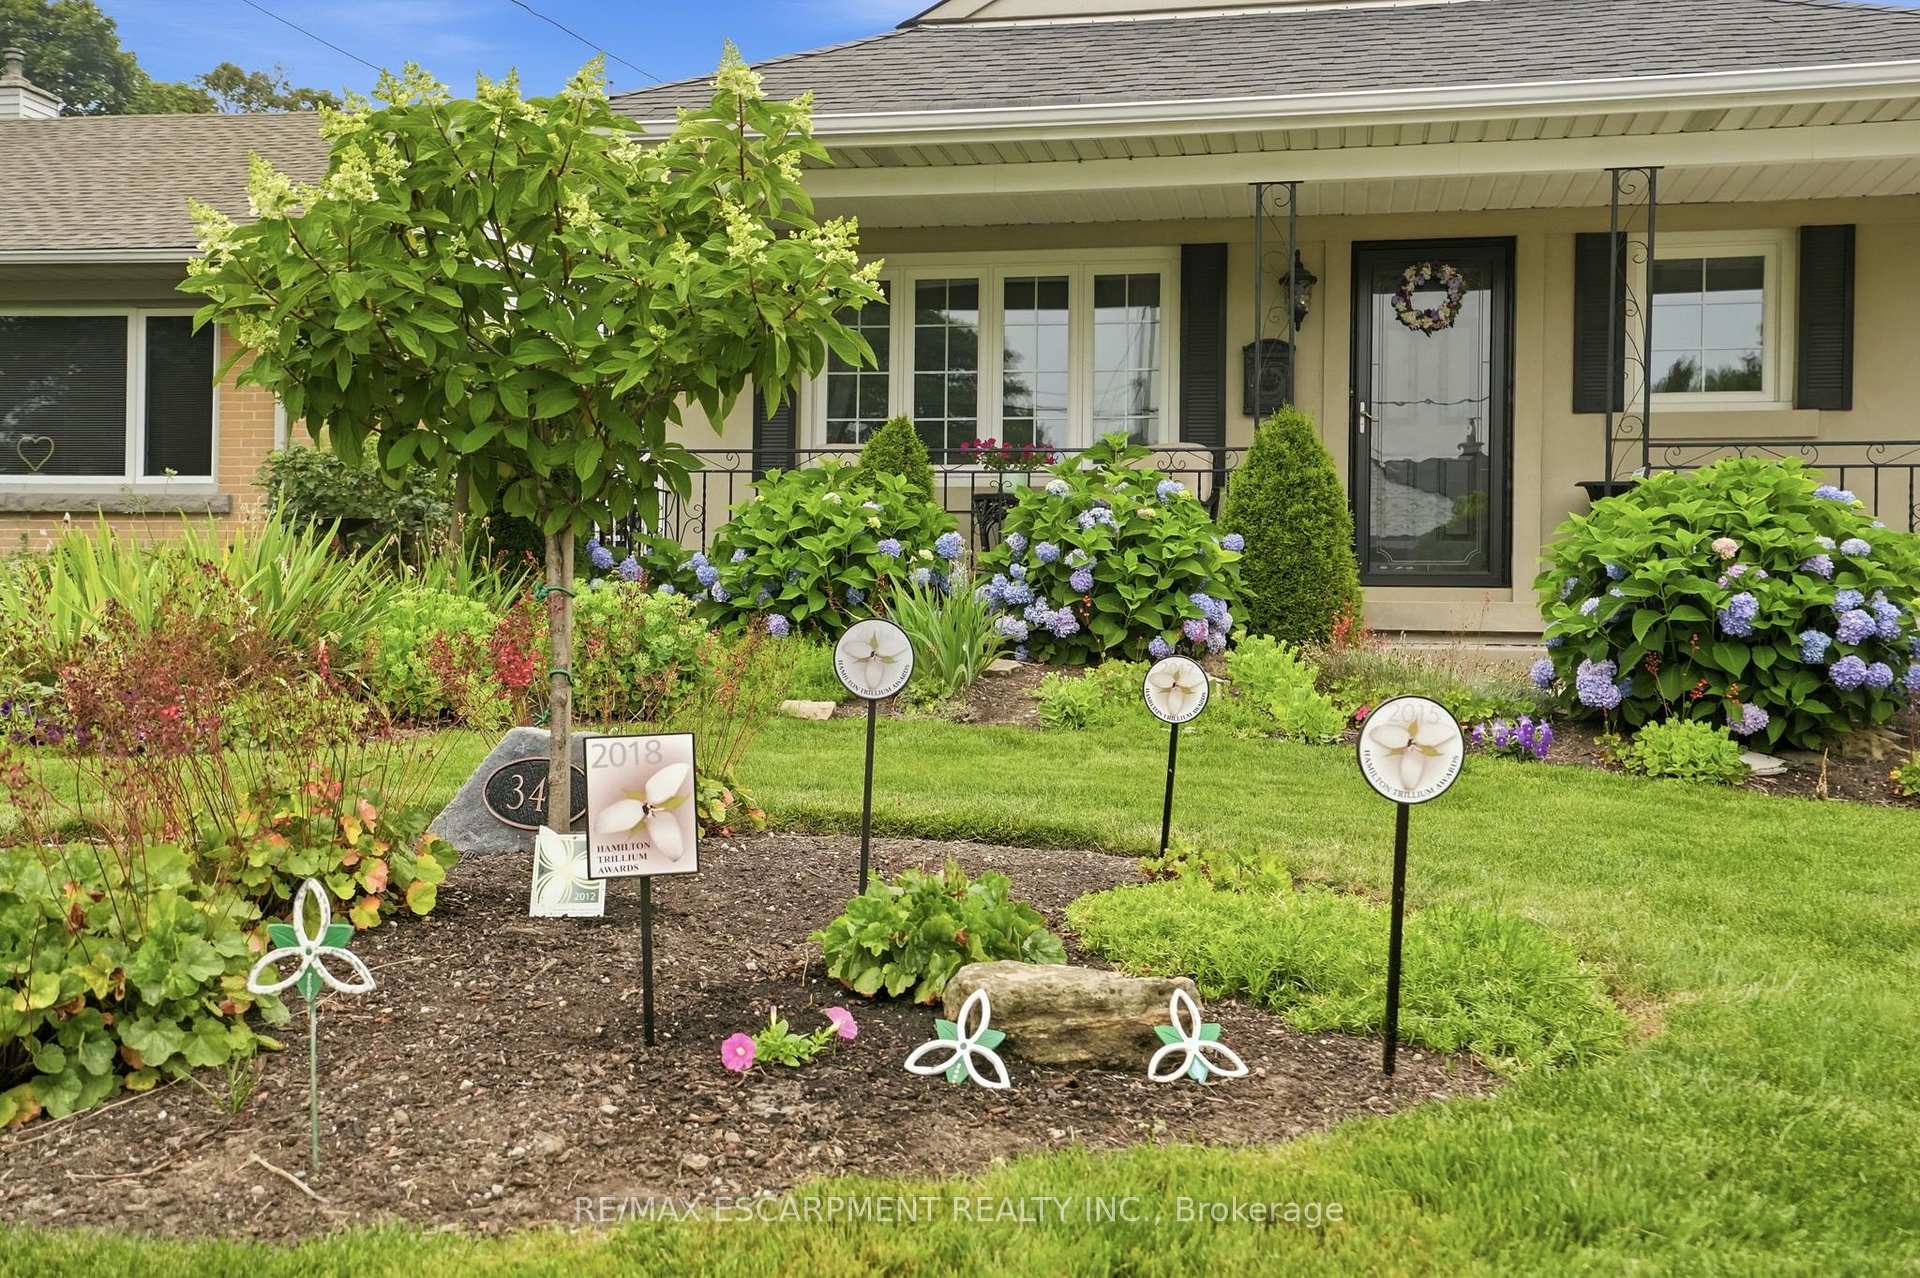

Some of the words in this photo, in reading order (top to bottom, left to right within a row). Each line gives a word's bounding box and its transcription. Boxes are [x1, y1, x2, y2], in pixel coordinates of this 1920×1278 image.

[591, 740, 663, 769] 2018
[1364, 749, 1391, 793] HAMILTON
[1391, 788, 1435, 799] TRILLIUM
[1435, 755, 1459, 788] AWARDS
[597, 841, 651, 853] HAMILTON
[599, 853, 648, 863] TRILLIUM
[598, 864, 640, 874] AWARDS
[575, 892, 596, 901] 2012
